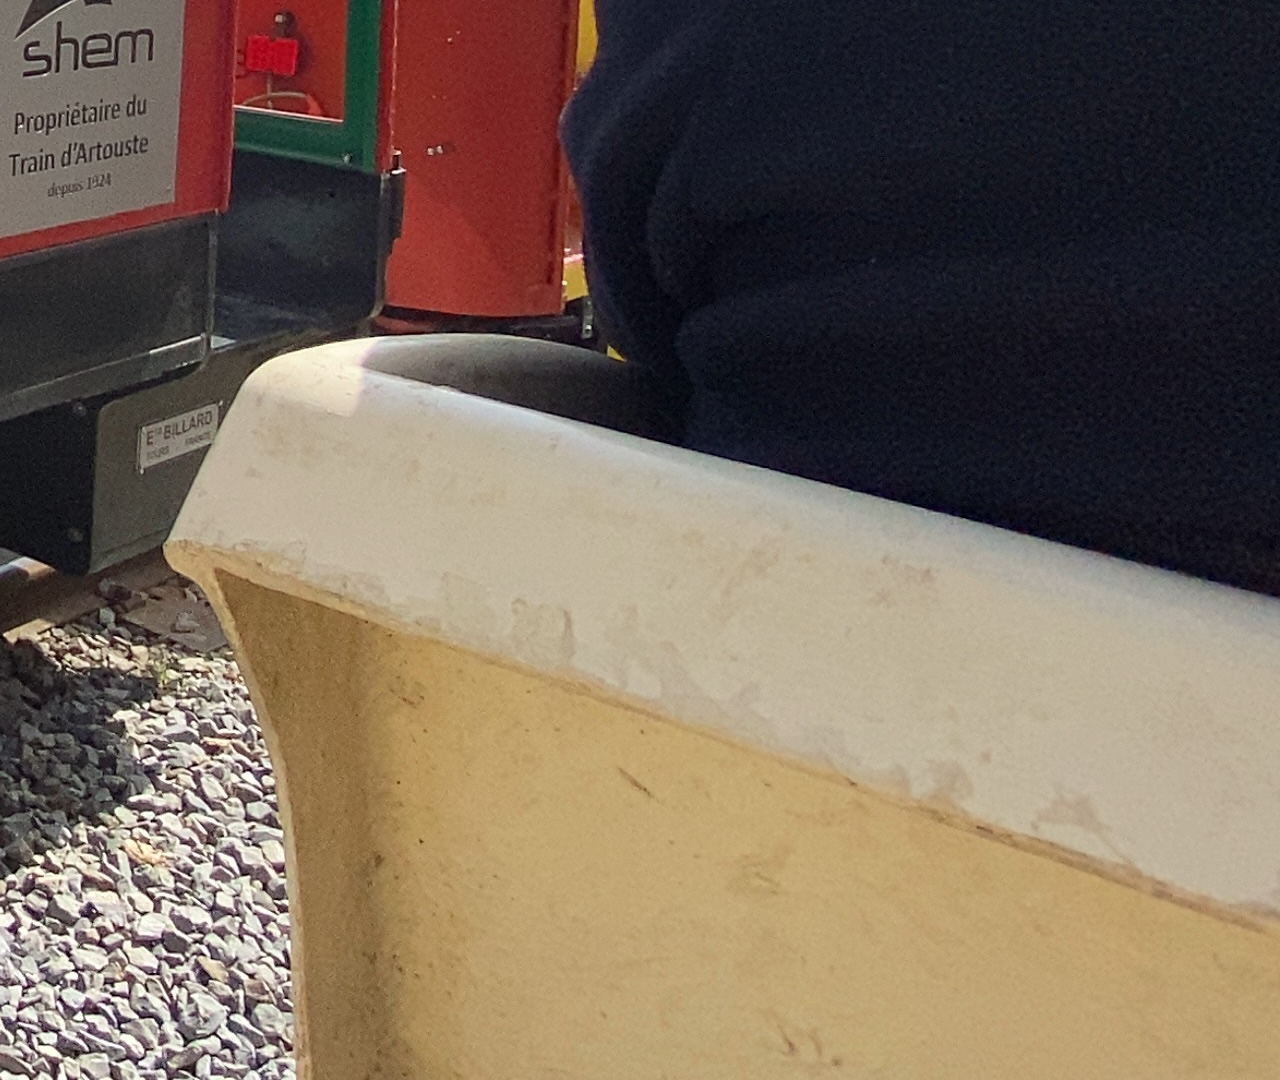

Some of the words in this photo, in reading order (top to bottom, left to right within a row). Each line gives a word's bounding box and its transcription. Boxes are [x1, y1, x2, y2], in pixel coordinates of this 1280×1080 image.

[22, 21, 154, 77] shem
[14, 98, 121, 136] Propriétaire
[126, 94, 147, 118] du
[8, 148, 55, 177] Train
[61, 135, 149, 169] d'Artouste
[47, 179, 84, 199] depuis
[164, 411, 213, 440] BILLARD
